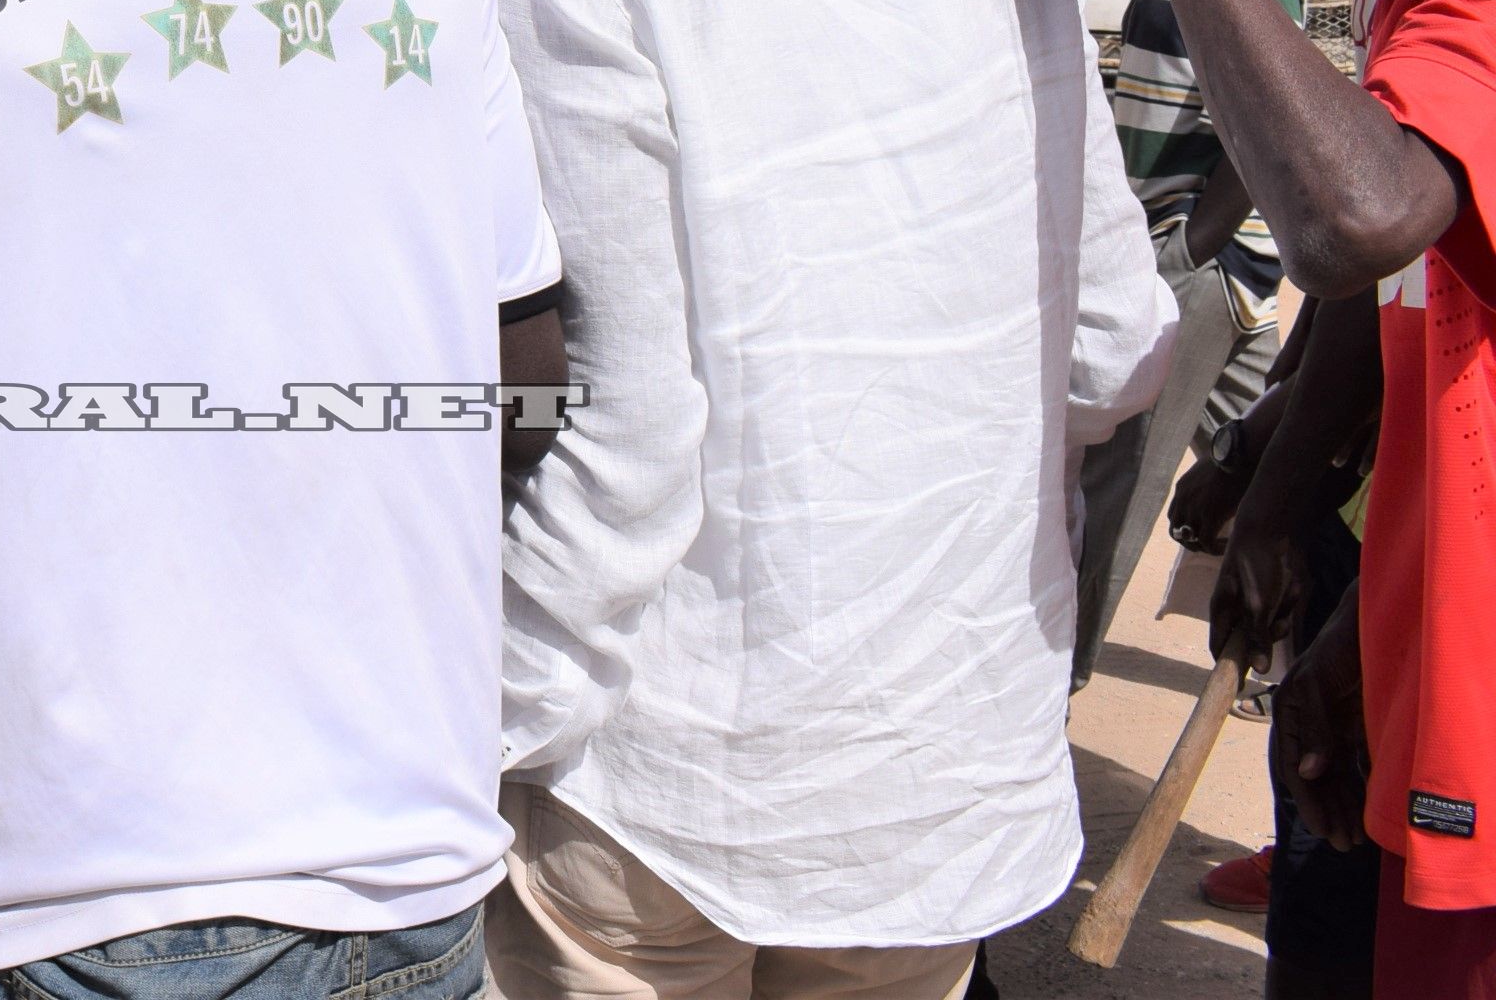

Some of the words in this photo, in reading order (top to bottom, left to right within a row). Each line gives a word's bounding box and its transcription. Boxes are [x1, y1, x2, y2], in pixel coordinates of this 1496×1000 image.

[62, 58, 112, 108] 54
[168, 11, 215, 54] 74
[389, 23, 425, 65] 14
[1415, 796, 1474, 814] AUTHENTIC
